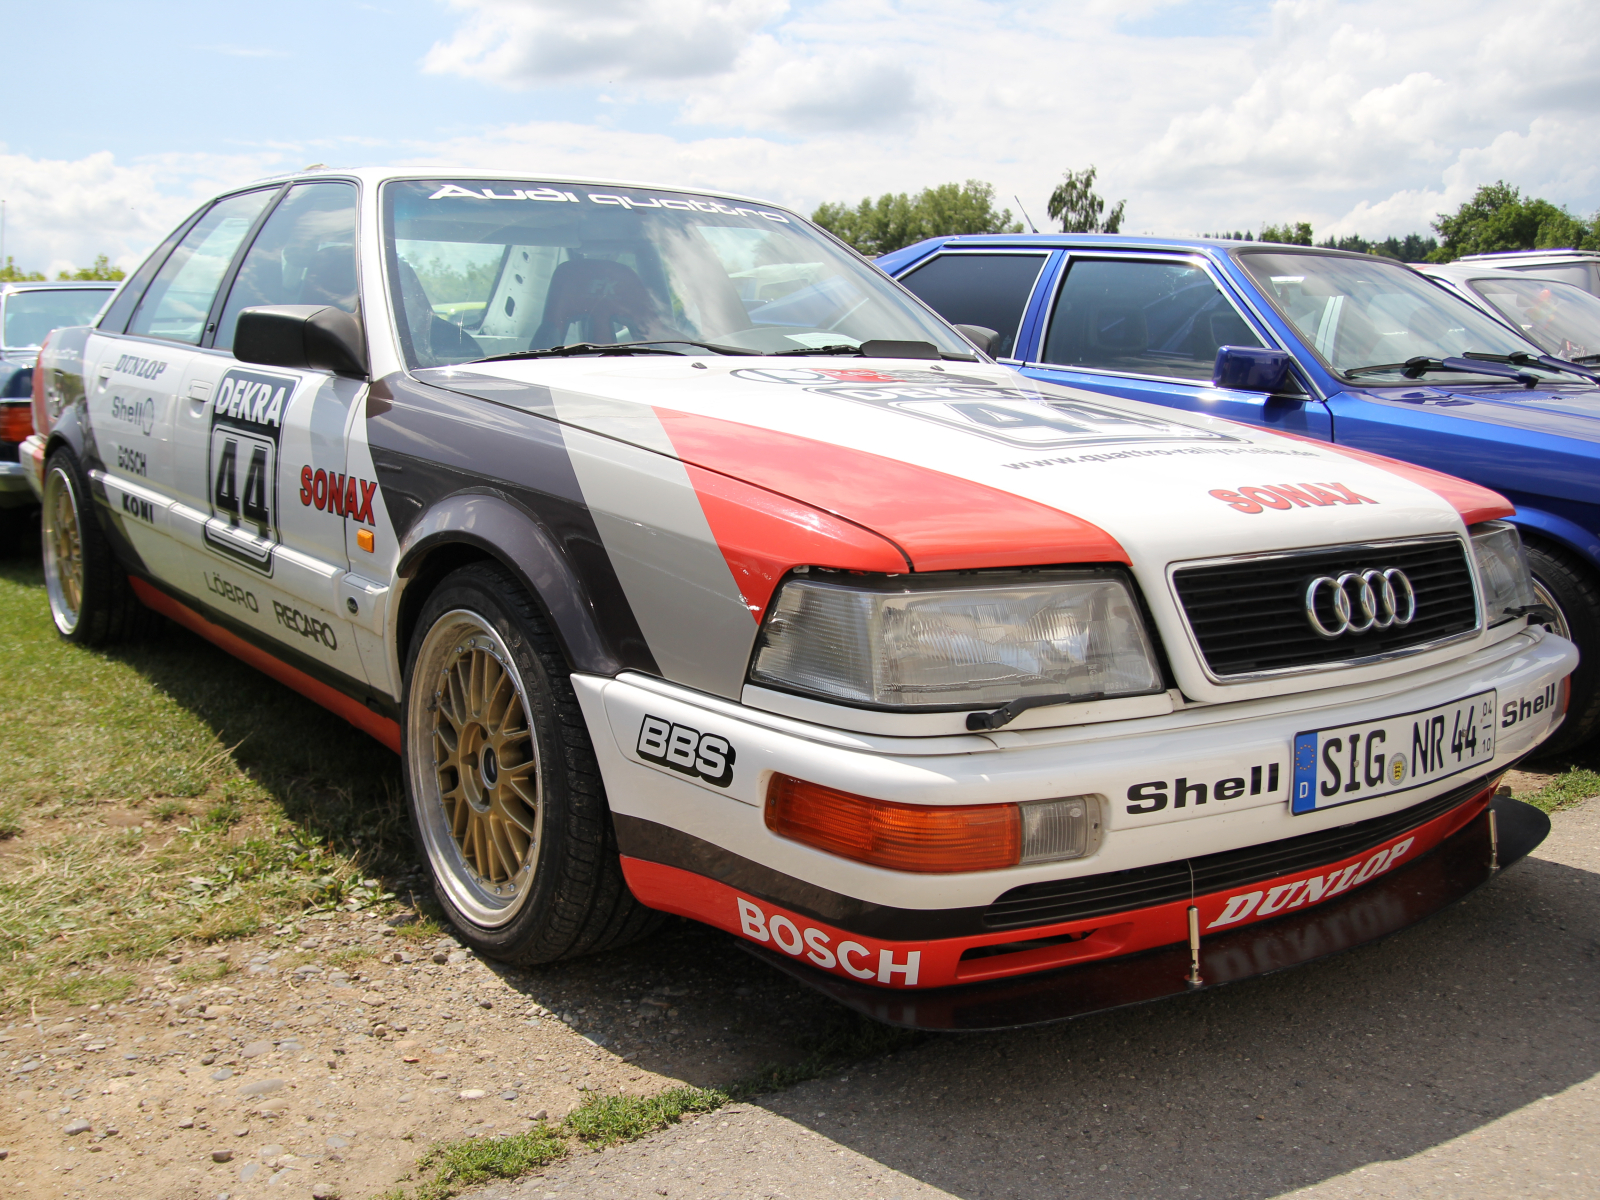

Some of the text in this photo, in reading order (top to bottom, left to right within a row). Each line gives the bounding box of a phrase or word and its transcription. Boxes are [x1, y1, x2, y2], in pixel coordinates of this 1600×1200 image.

[428, 184, 790, 224] Audi quattro
[114, 354, 167, 380] DUNLOP
[111, 396, 142, 426] Shell
[215, 378, 287, 427] DEKRA
[118, 445, 147, 477] BOSCH
[122, 493, 154, 524] KONI
[216, 437, 273, 545] 44
[300, 464, 378, 527] SONAX
[1208, 482, 1380, 514] SONAX
[204, 572, 259, 613] LÖBRO
[272, 599, 338, 651] RECARO
[1482, 701, 1493, 717] 04
[1502, 682, 1556, 729] Shell
[636, 713, 737, 788] BBS
[1320, 728, 1386, 797] SIG
[1411, 715, 1445, 778] NR
[1450, 706, 1477, 762] 44
[1481, 739, 1492, 754] 10
[1126, 762, 1279, 815] Shell
[1299, 781, 1308, 798] D
[1206, 836, 1415, 929] DUNLOP
[737, 896, 921, 985] BOSCH
